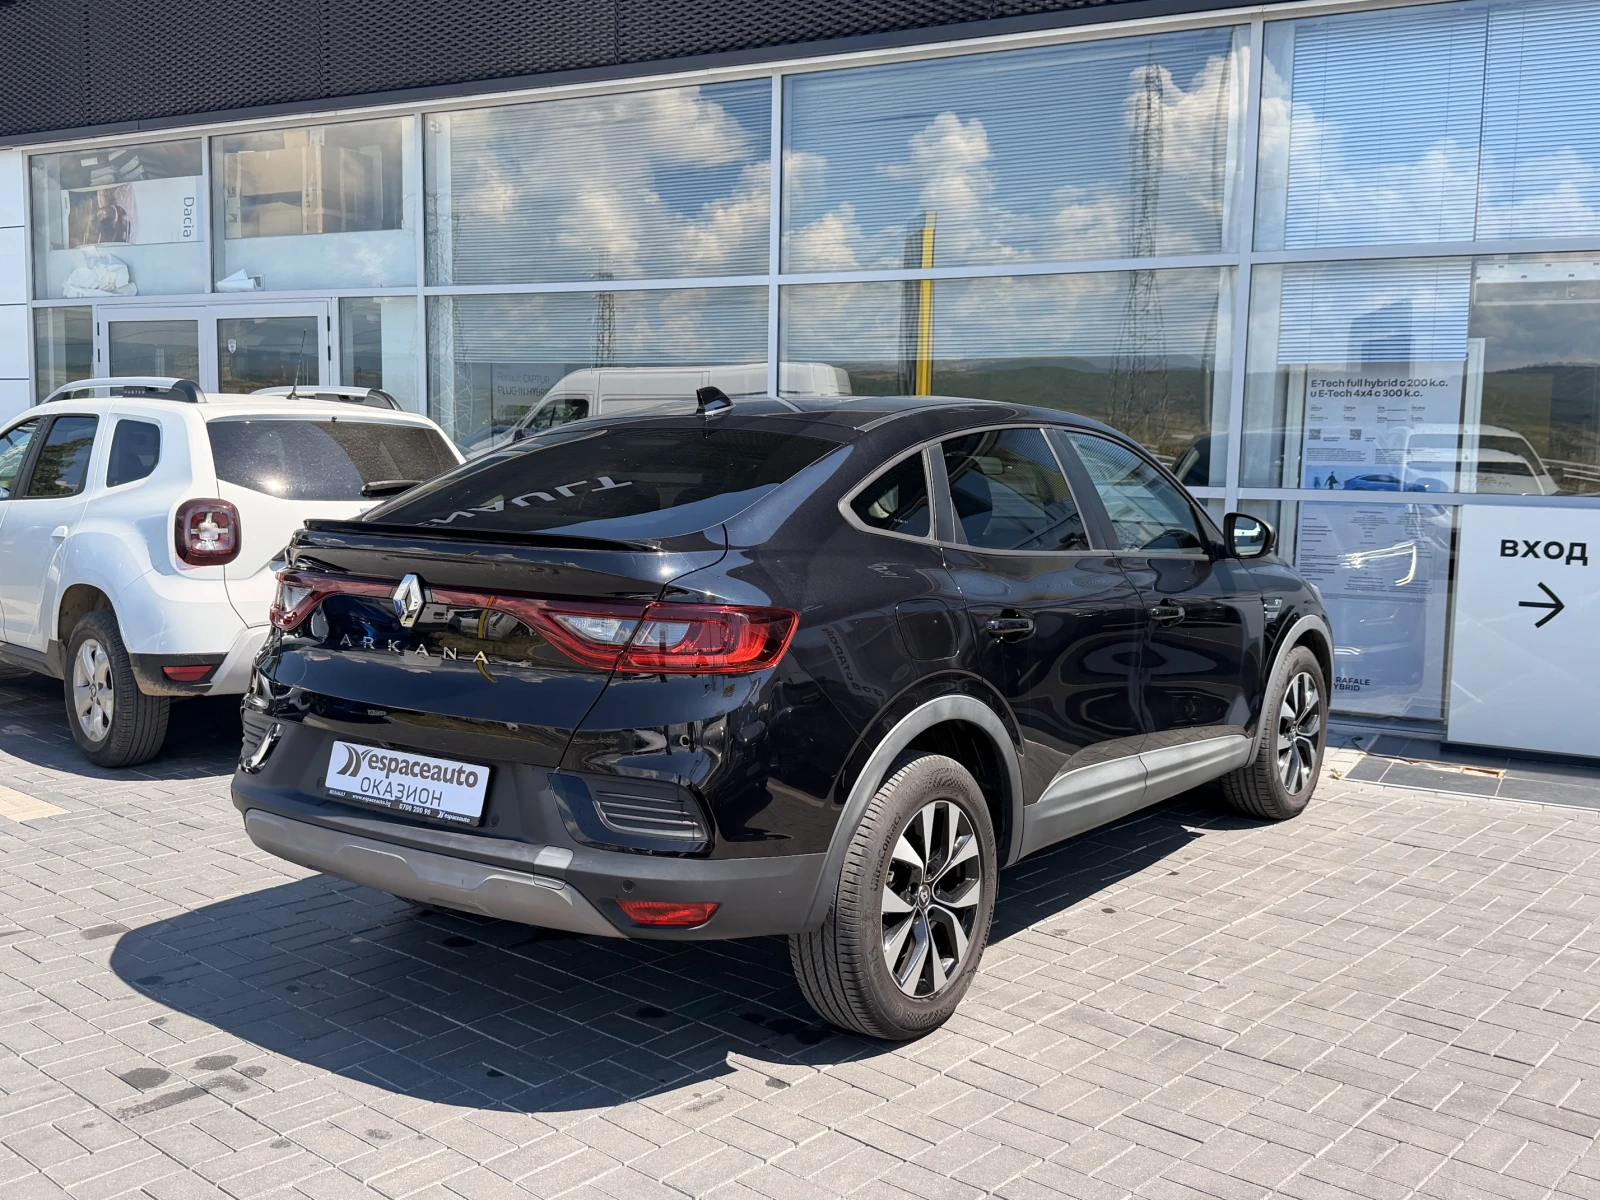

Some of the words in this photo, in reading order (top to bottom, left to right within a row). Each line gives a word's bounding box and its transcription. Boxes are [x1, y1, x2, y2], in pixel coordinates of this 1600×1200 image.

[182, 196, 195, 238] Dacia
[497, 385, 526, 396] PLUG-IN
[1311, 379, 1345, 388] E-Tech
[1346, 378, 1363, 388] full
[1364, 378, 1398, 389] hybrid
[1407, 378, 1428, 387] 200
[1318, 389, 1353, 398] E-Tech
[1353, 389, 1374, 397] 4x4
[1383, 389, 1403, 397] 300
[1500, 538, 1589, 567] ВХОД
[339, 633, 490, 665] ARKANA
[1333, 683, 1361, 692] YBRID
[1335, 676, 1371, 686] RAFALE
[367, 752, 479, 788] espaceauto
[360, 776, 443, 808] ОКАЗИОН
